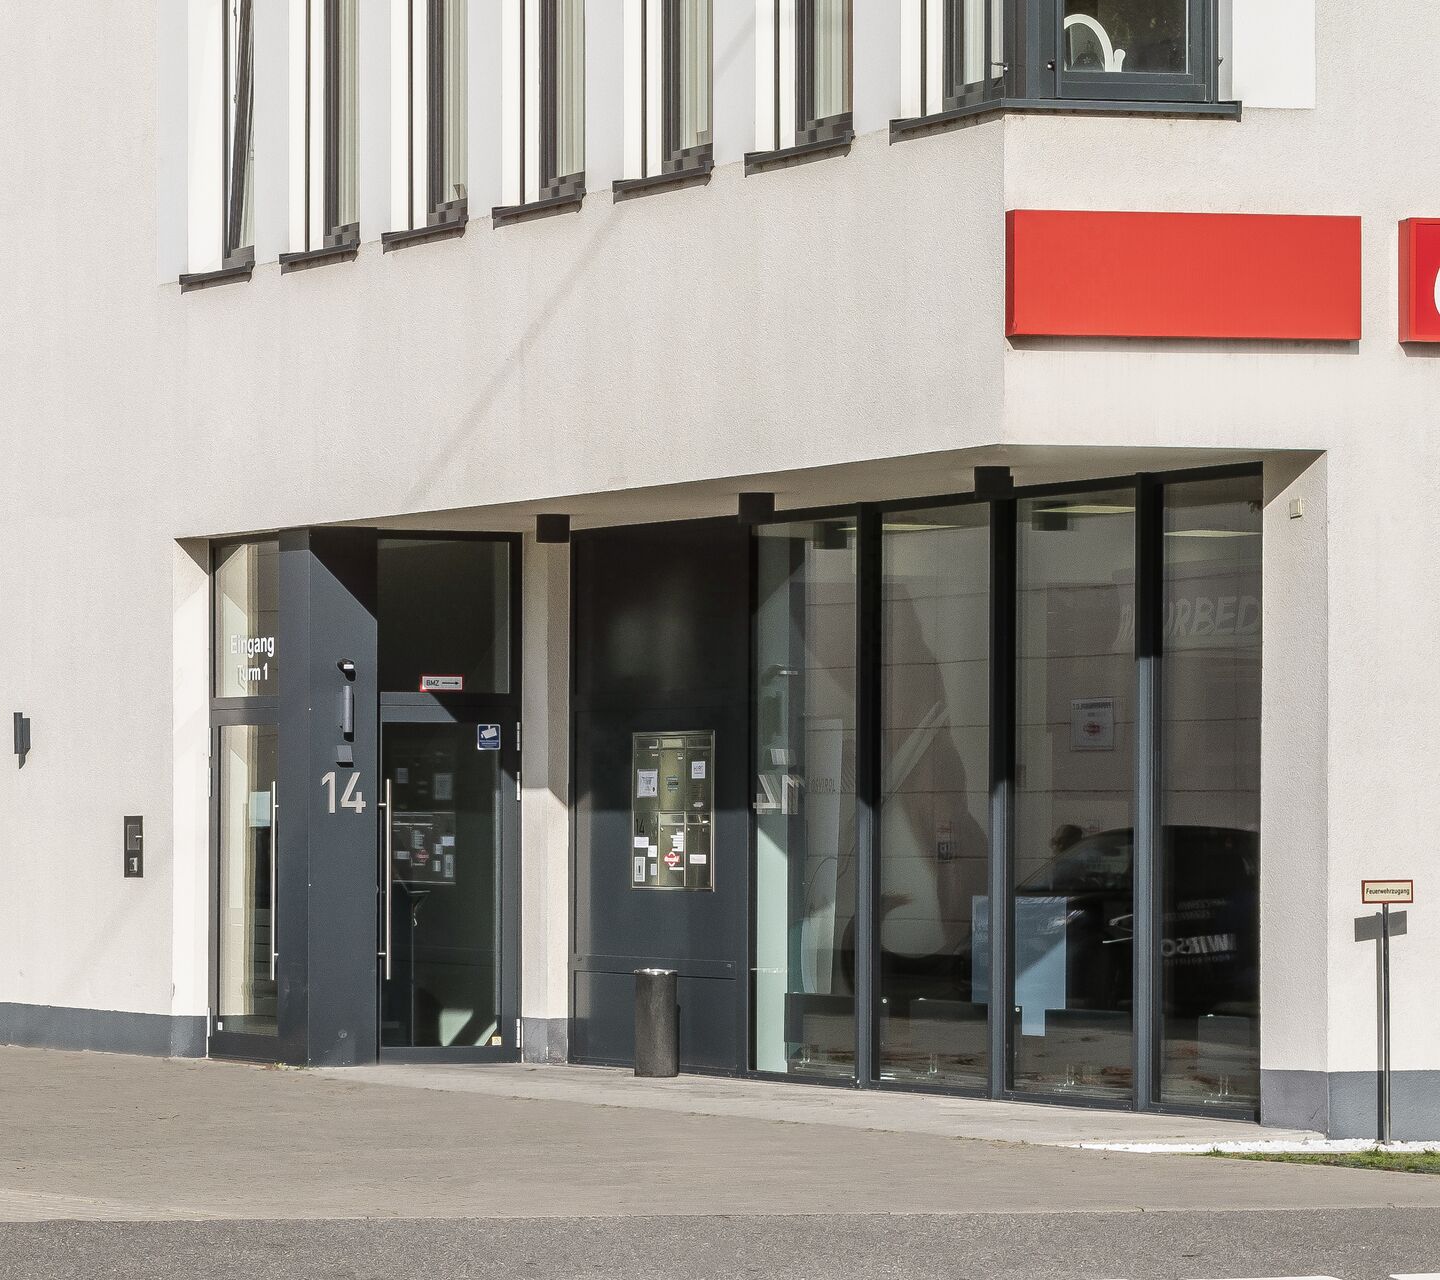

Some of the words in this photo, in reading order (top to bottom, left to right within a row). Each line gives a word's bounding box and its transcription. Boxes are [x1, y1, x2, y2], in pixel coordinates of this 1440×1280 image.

[231, 634, 274, 658] Eingang
[237, 663, 261, 681] Turm
[262, 662, 268, 681] 1
[426, 679, 440, 687] BMZ
[321, 771, 367, 814] 14
[1365, 887, 1410, 896] Feuerwehrzugang
